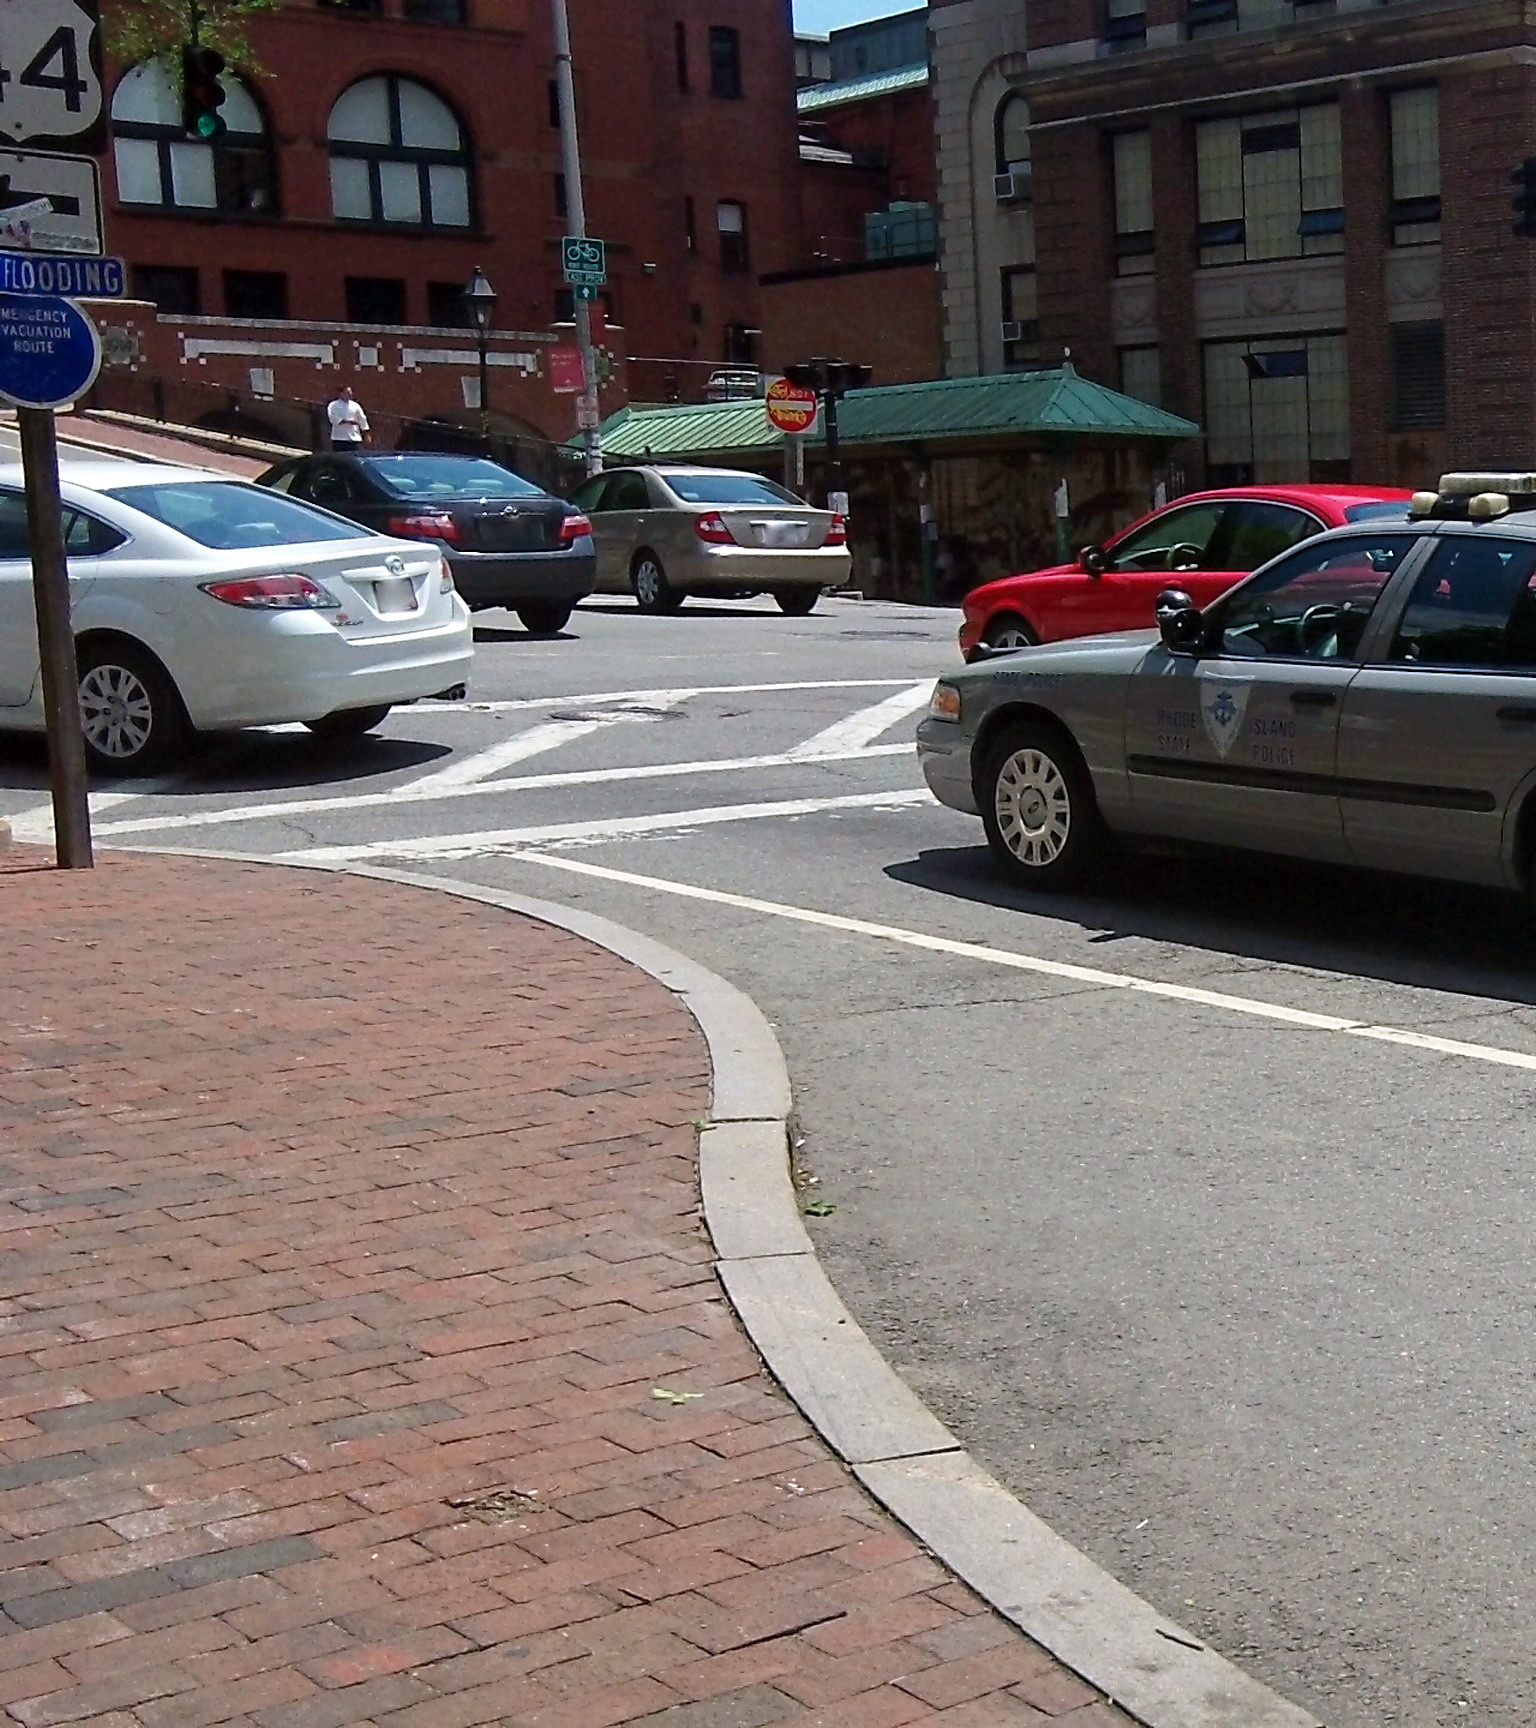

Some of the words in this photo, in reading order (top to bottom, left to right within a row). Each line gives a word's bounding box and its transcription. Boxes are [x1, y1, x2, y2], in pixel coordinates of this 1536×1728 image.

[4, 258, 119, 292] FLOODING
[0, 307, 68, 323] MEGENCY
[0, 325, 71, 339] VACUATION
[13, 341, 55, 354] ROUTE
